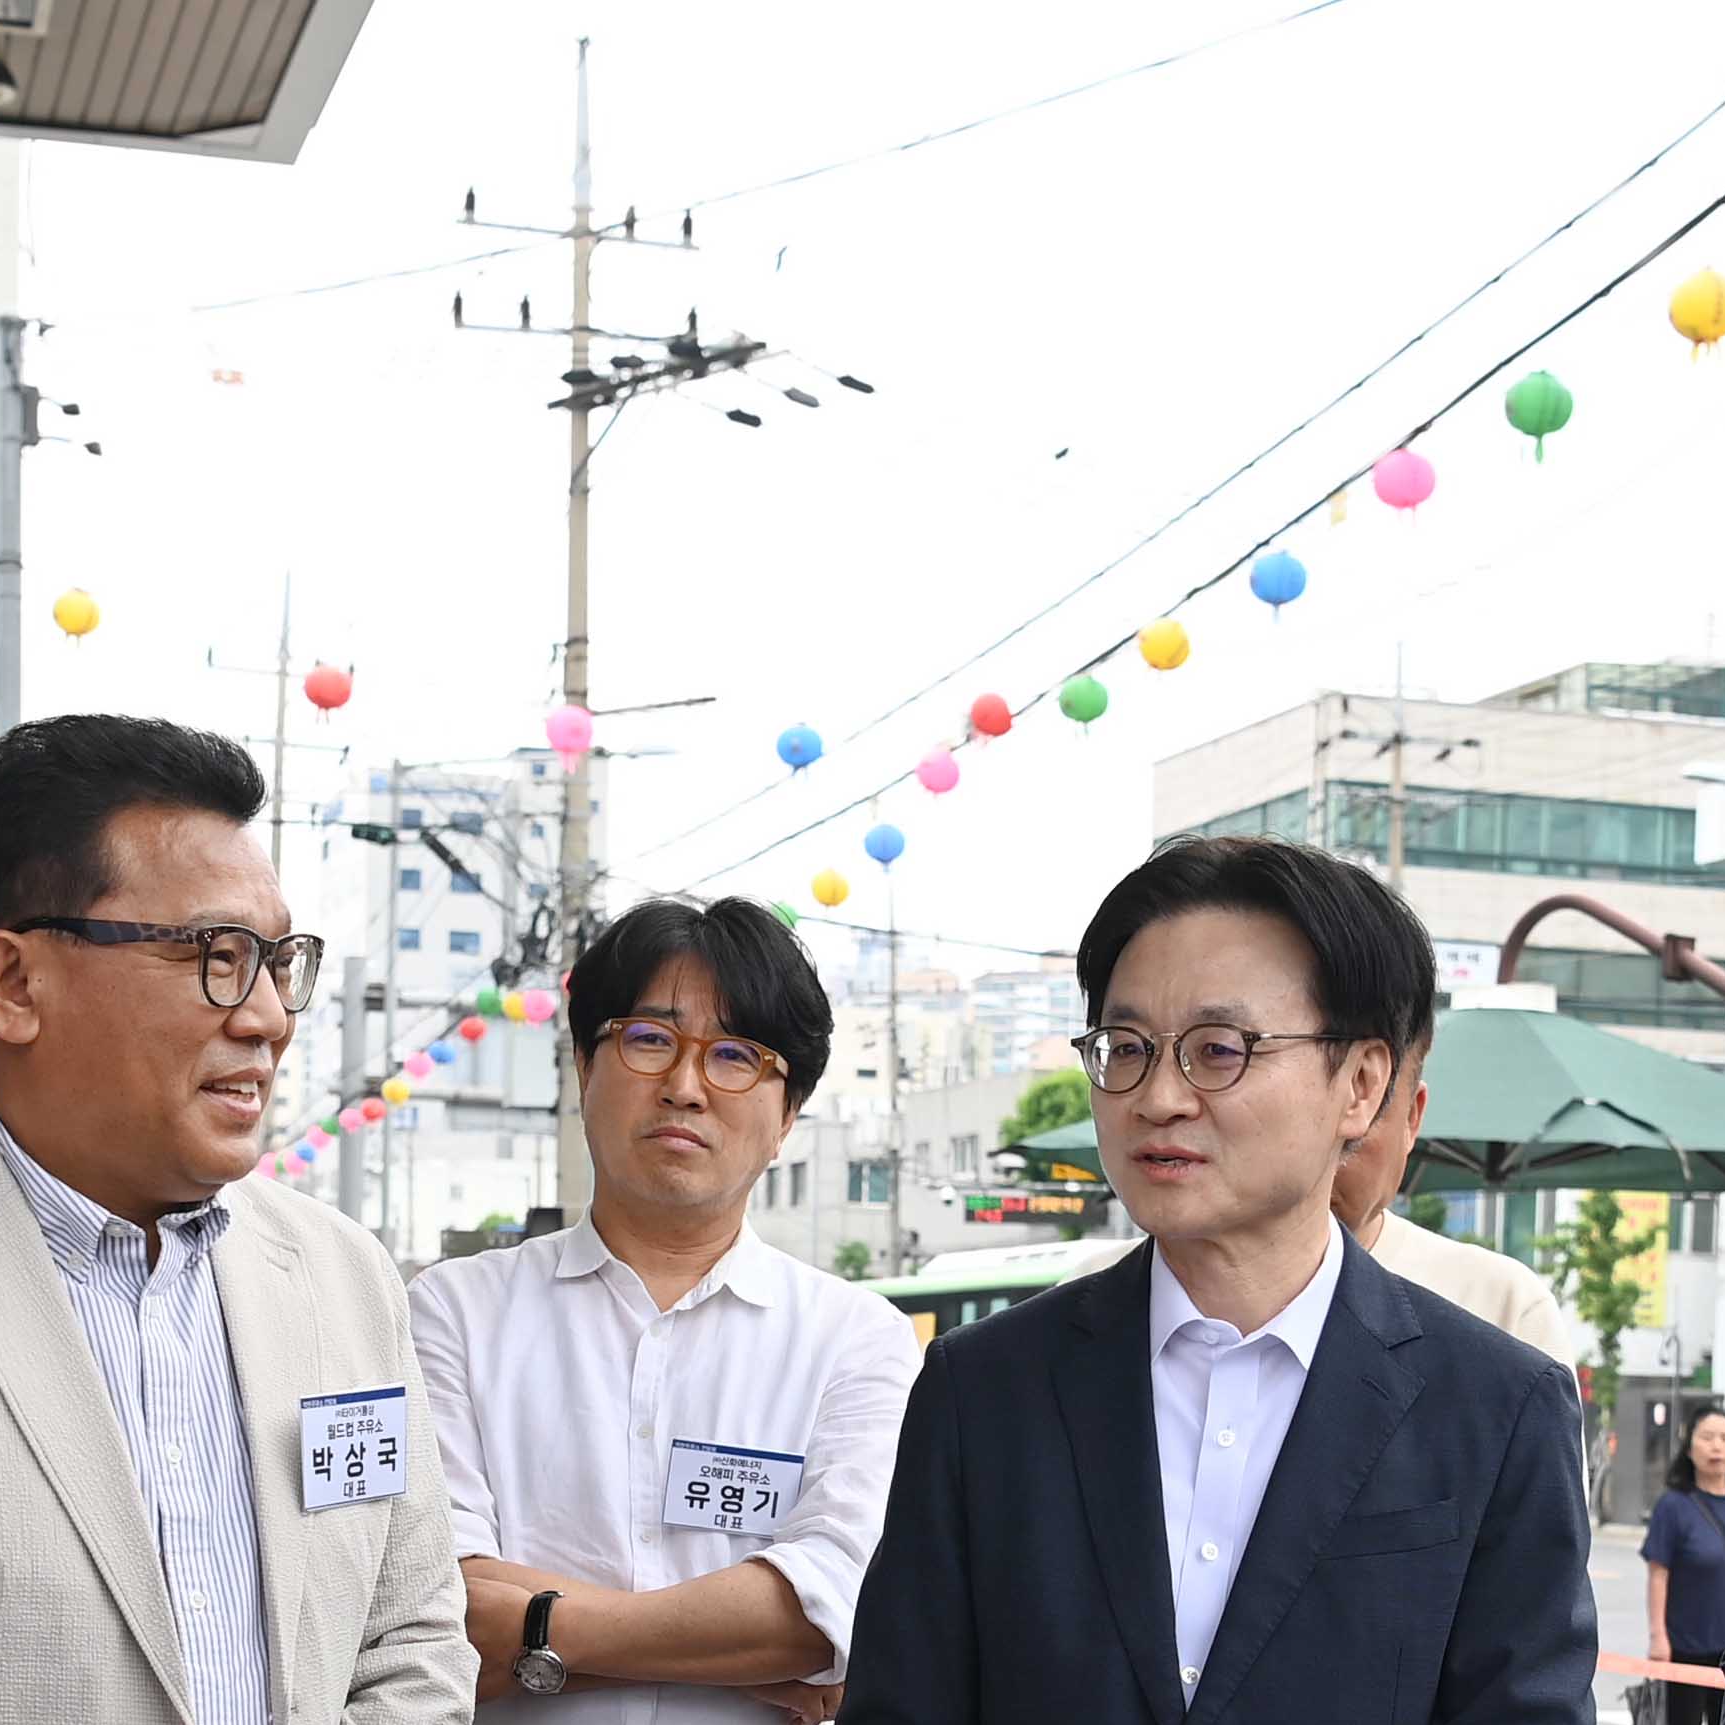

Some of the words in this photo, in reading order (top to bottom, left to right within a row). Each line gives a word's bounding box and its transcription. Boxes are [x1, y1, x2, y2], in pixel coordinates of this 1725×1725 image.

[327, 1421, 354, 1440] 월드컵
[356, 1418, 384, 1436] 주유소
[699, 1465, 735, 1481] 오해피
[736, 1470, 771, 1486] 주유소
